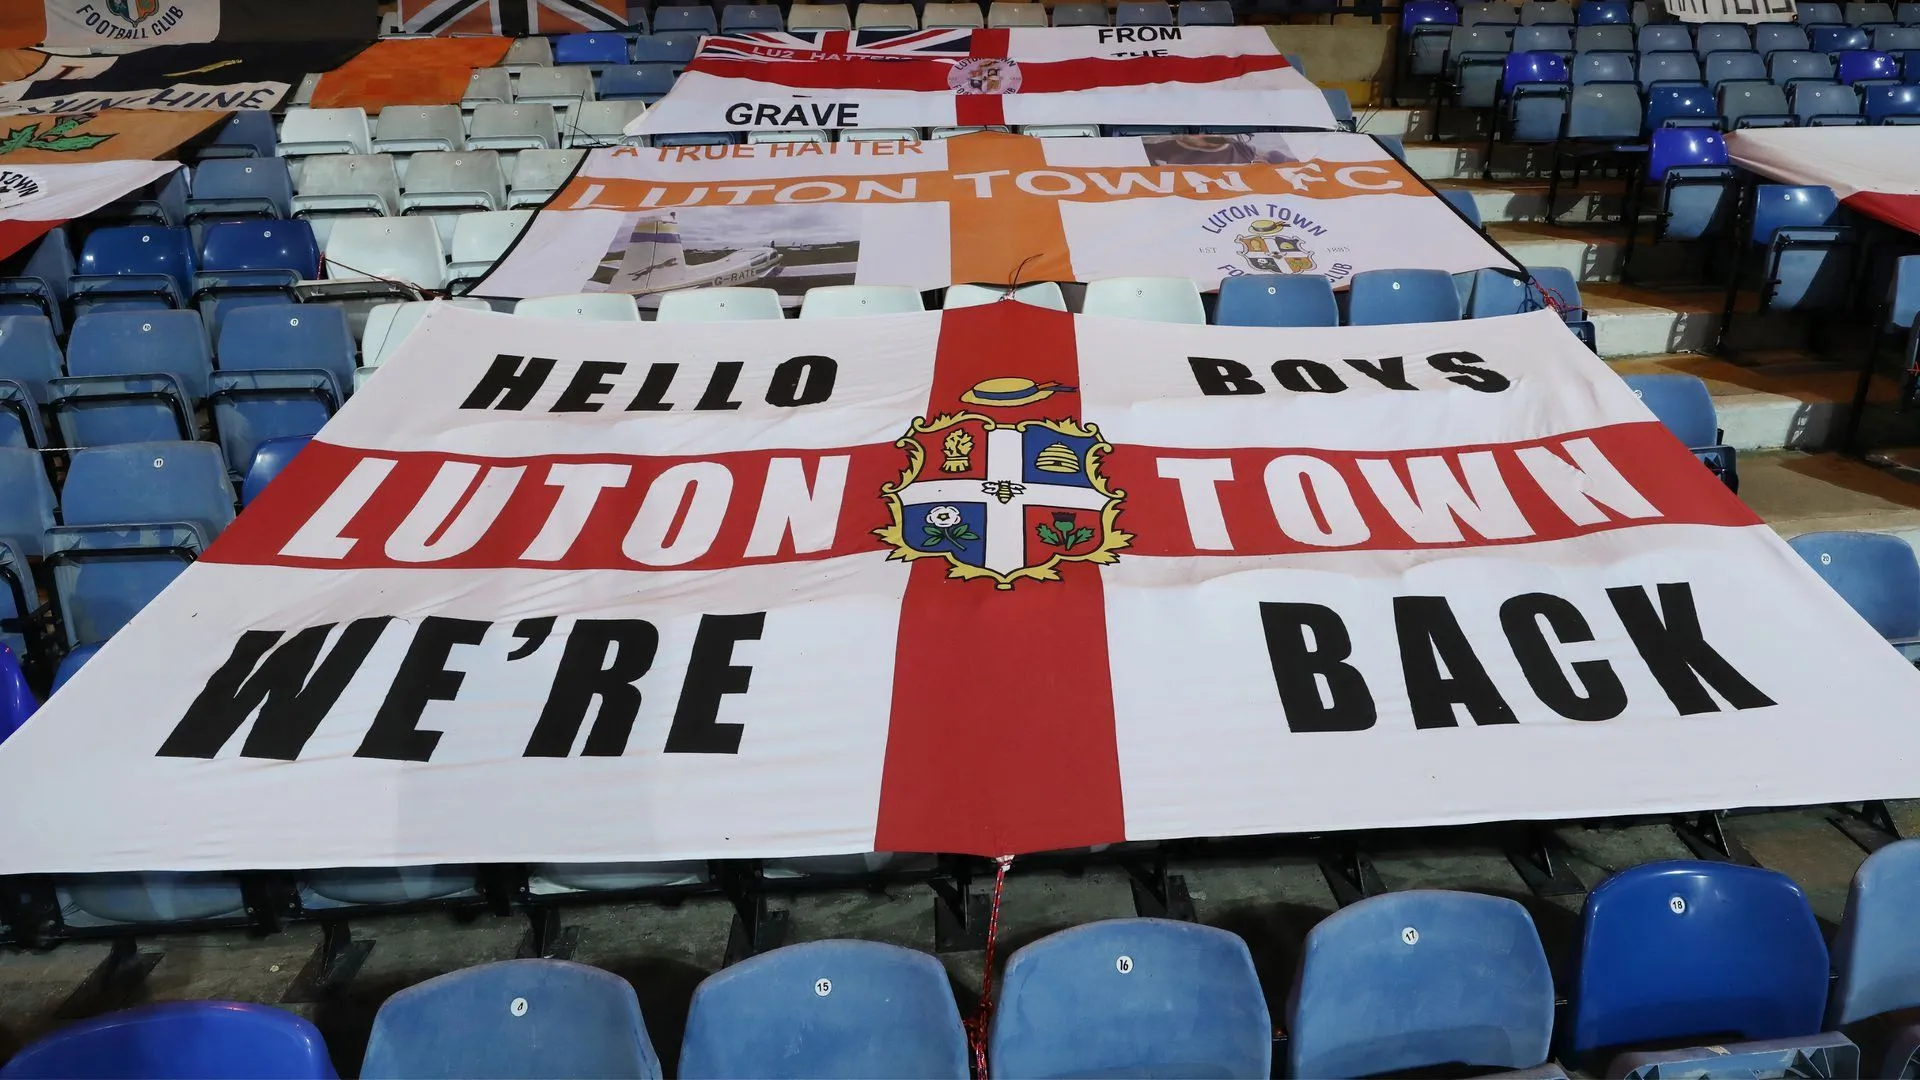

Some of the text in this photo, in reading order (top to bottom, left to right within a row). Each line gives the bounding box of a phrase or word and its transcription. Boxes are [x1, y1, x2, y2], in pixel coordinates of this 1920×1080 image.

[76, 4, 184, 40] FOOTBALL CLUB
[1098, 26, 1182, 44] FROM
[752, 47, 794, 59] LU2
[725, 102, 860, 127] GRAVE
[657, 143, 755, 163] TRUE
[769, 140, 924, 158] HATTER
[568, 162, 1404, 209] LUTON TOWN FC
[1202, 203, 1328, 237] LUTON TOWN
[459, 350, 1510, 412] HELLO BOYS
[277, 437, 1663, 566] LUTON TOWN
[155, 581, 1779, 762] WE'RE BACK
[1672, 900, 1683, 910] 18
[1406, 930, 1416, 942] 17
[1119, 959, 1129, 971] 16
[817, 983, 828, 992] 15
